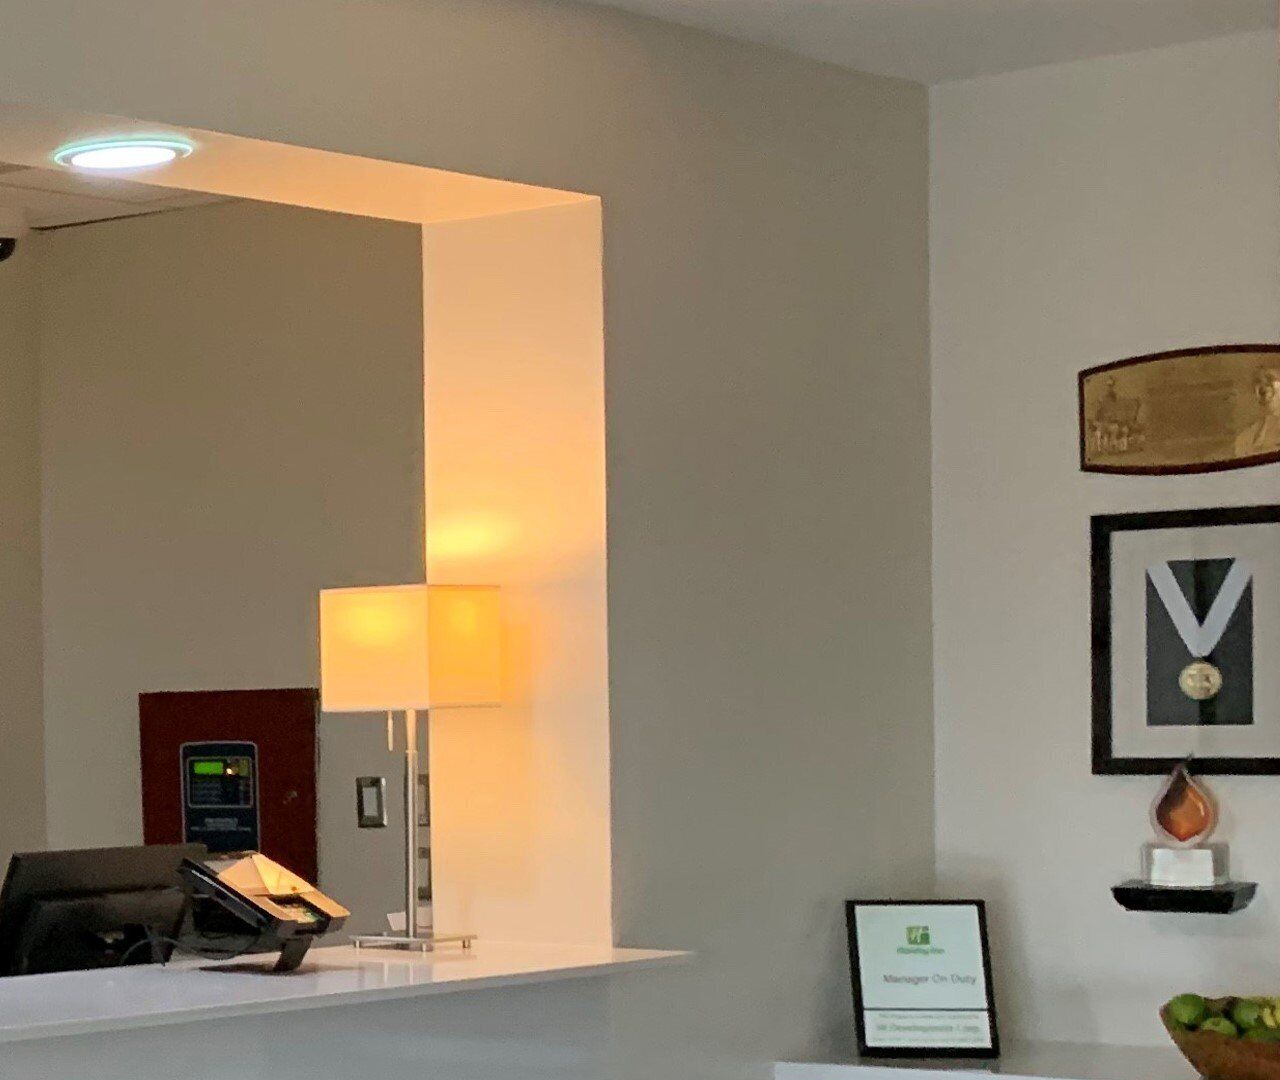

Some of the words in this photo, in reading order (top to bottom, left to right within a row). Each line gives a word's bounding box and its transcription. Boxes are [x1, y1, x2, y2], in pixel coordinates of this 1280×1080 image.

[883, 974, 929, 985] Manager
[932, 974, 948, 983] On
[950, 974, 976, 985] Duty
